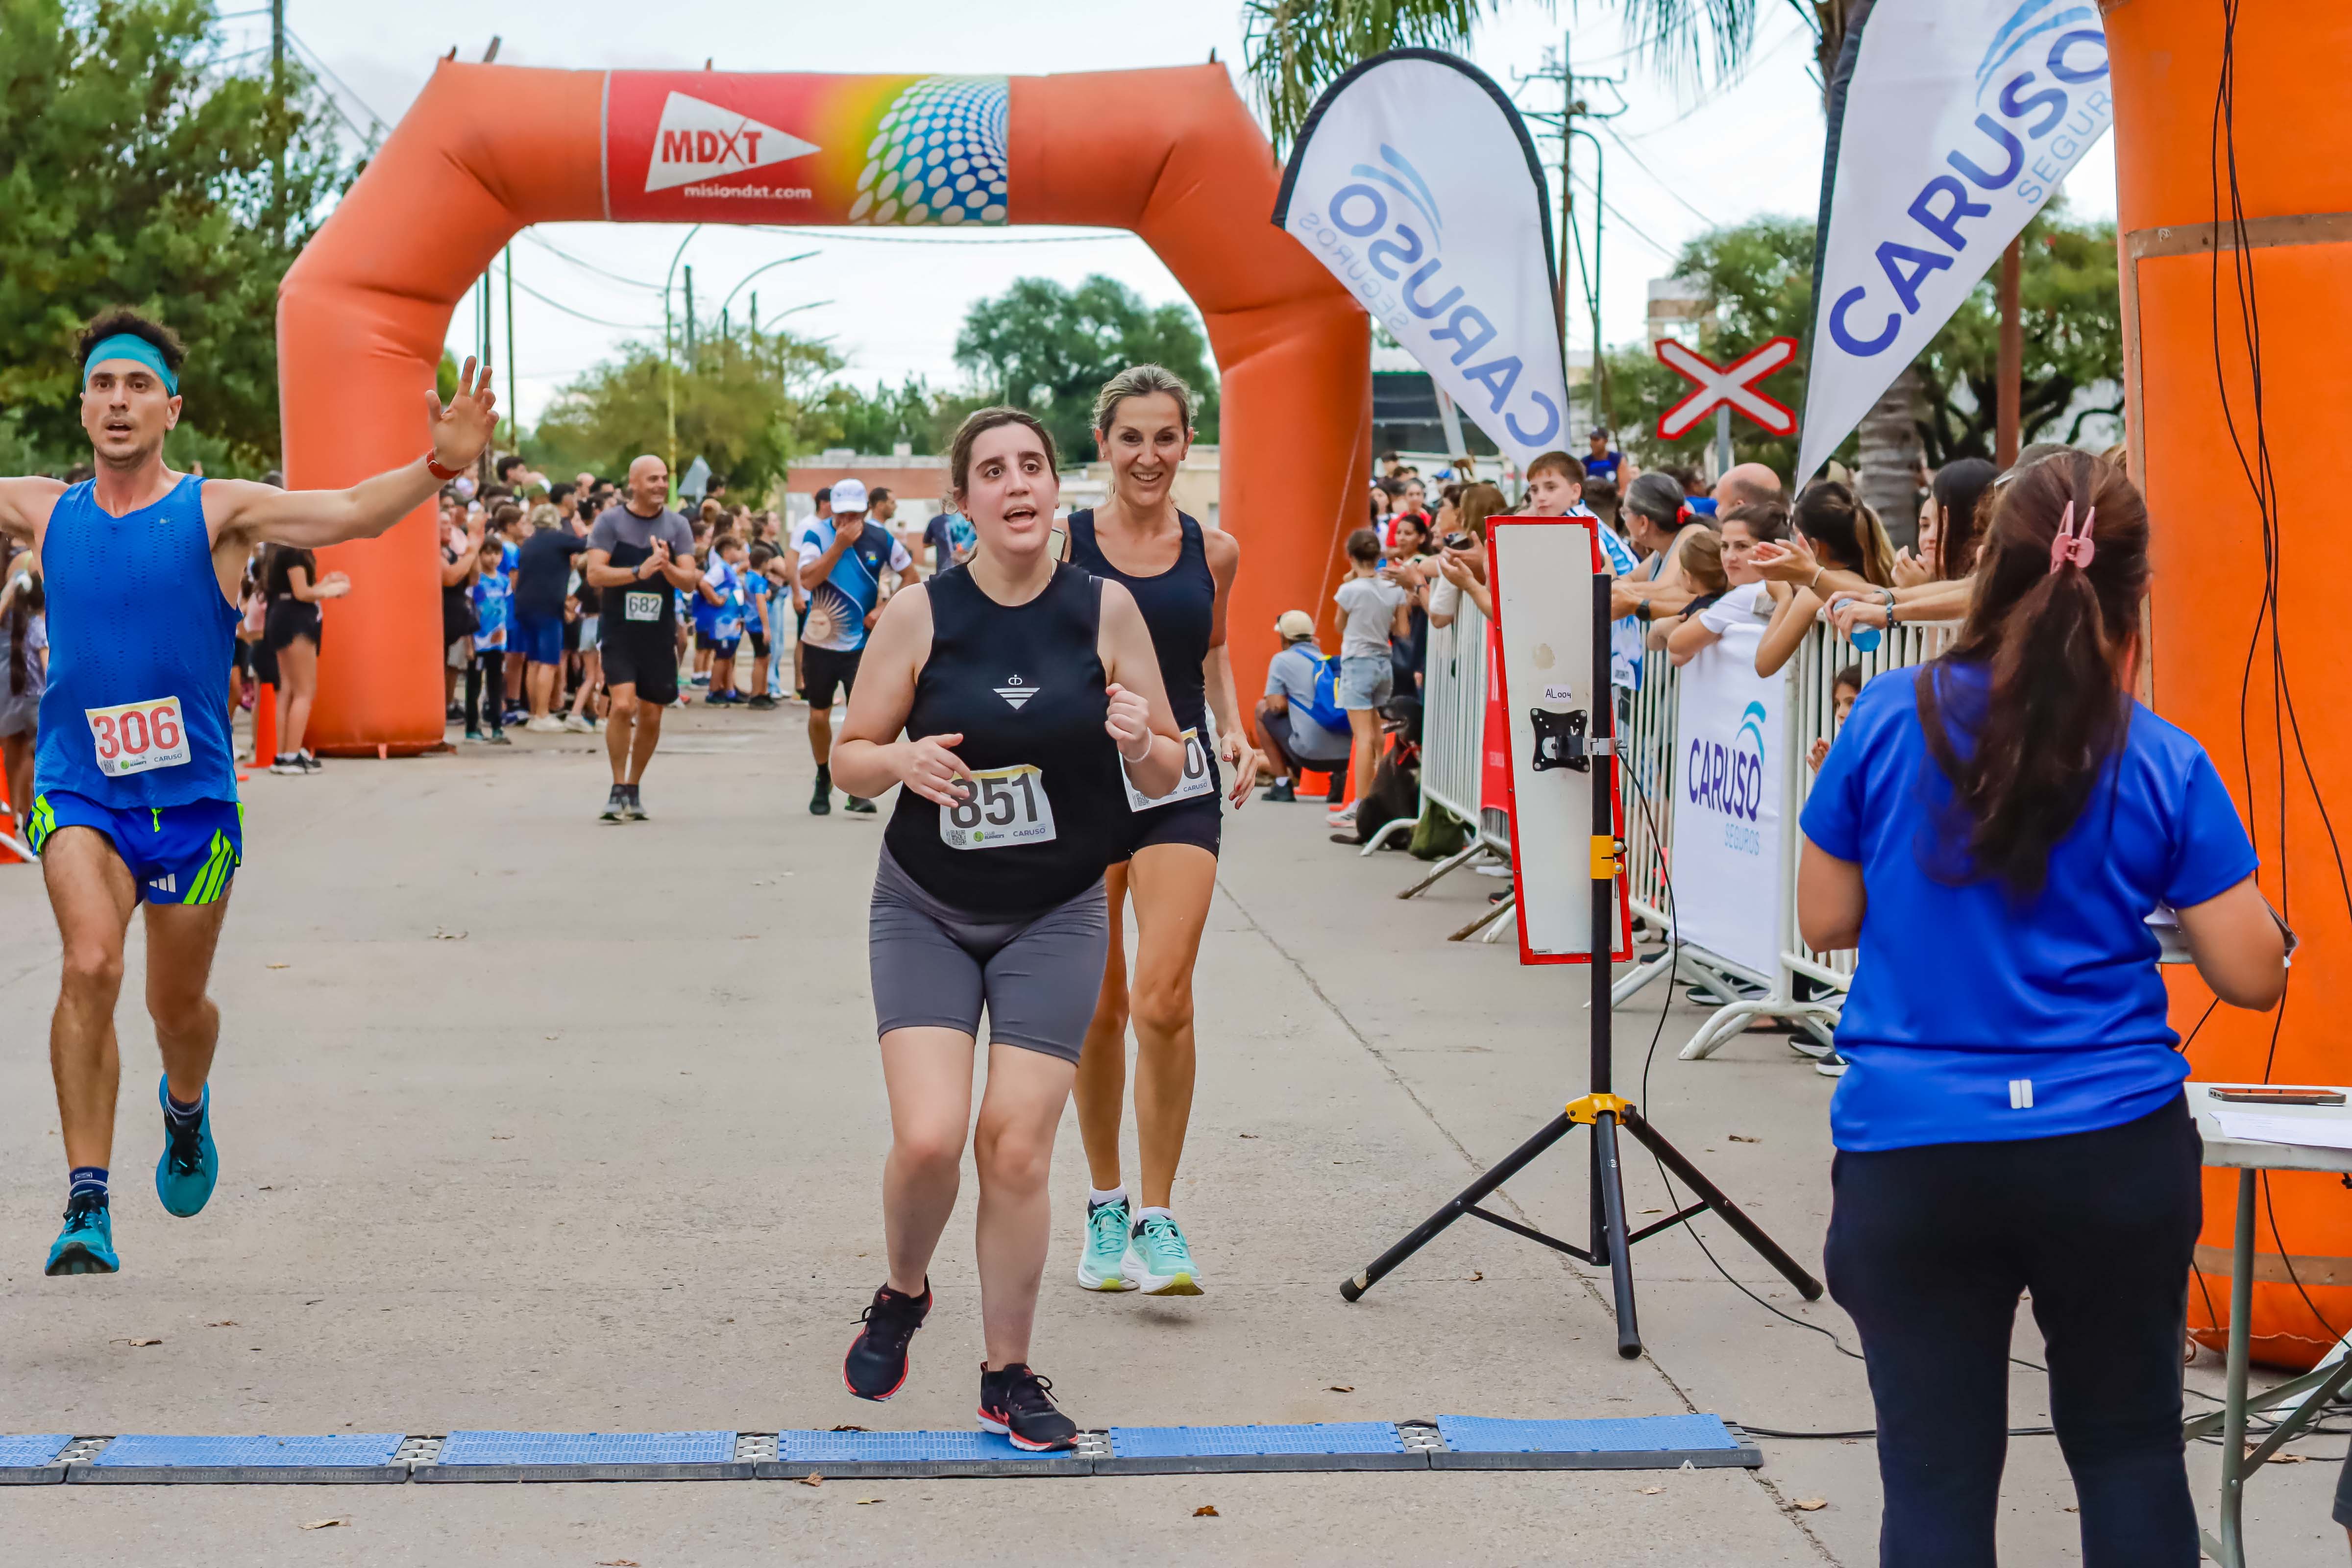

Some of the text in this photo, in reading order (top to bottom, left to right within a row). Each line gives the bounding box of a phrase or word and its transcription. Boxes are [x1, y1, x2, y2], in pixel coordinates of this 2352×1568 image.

[662, 118, 762, 166] MDXT
[2017, 90, 2112, 204] SEGUR
[684, 184, 812, 198] misiondxt.com
[1829, 29, 2109, 357] CARUSO
[629, 596, 659, 613] 682
[94, 706, 180, 759] 306
[154, 753, 182, 762] CARUSO
[1183, 783, 1207, 792] CARUSO
[1689, 738, 1761, 822] CARUSO
[950, 773, 1038, 829] 851
[1013, 828, 1046, 837] CARUSO
[1724, 823, 1760, 856] SEGUROS
